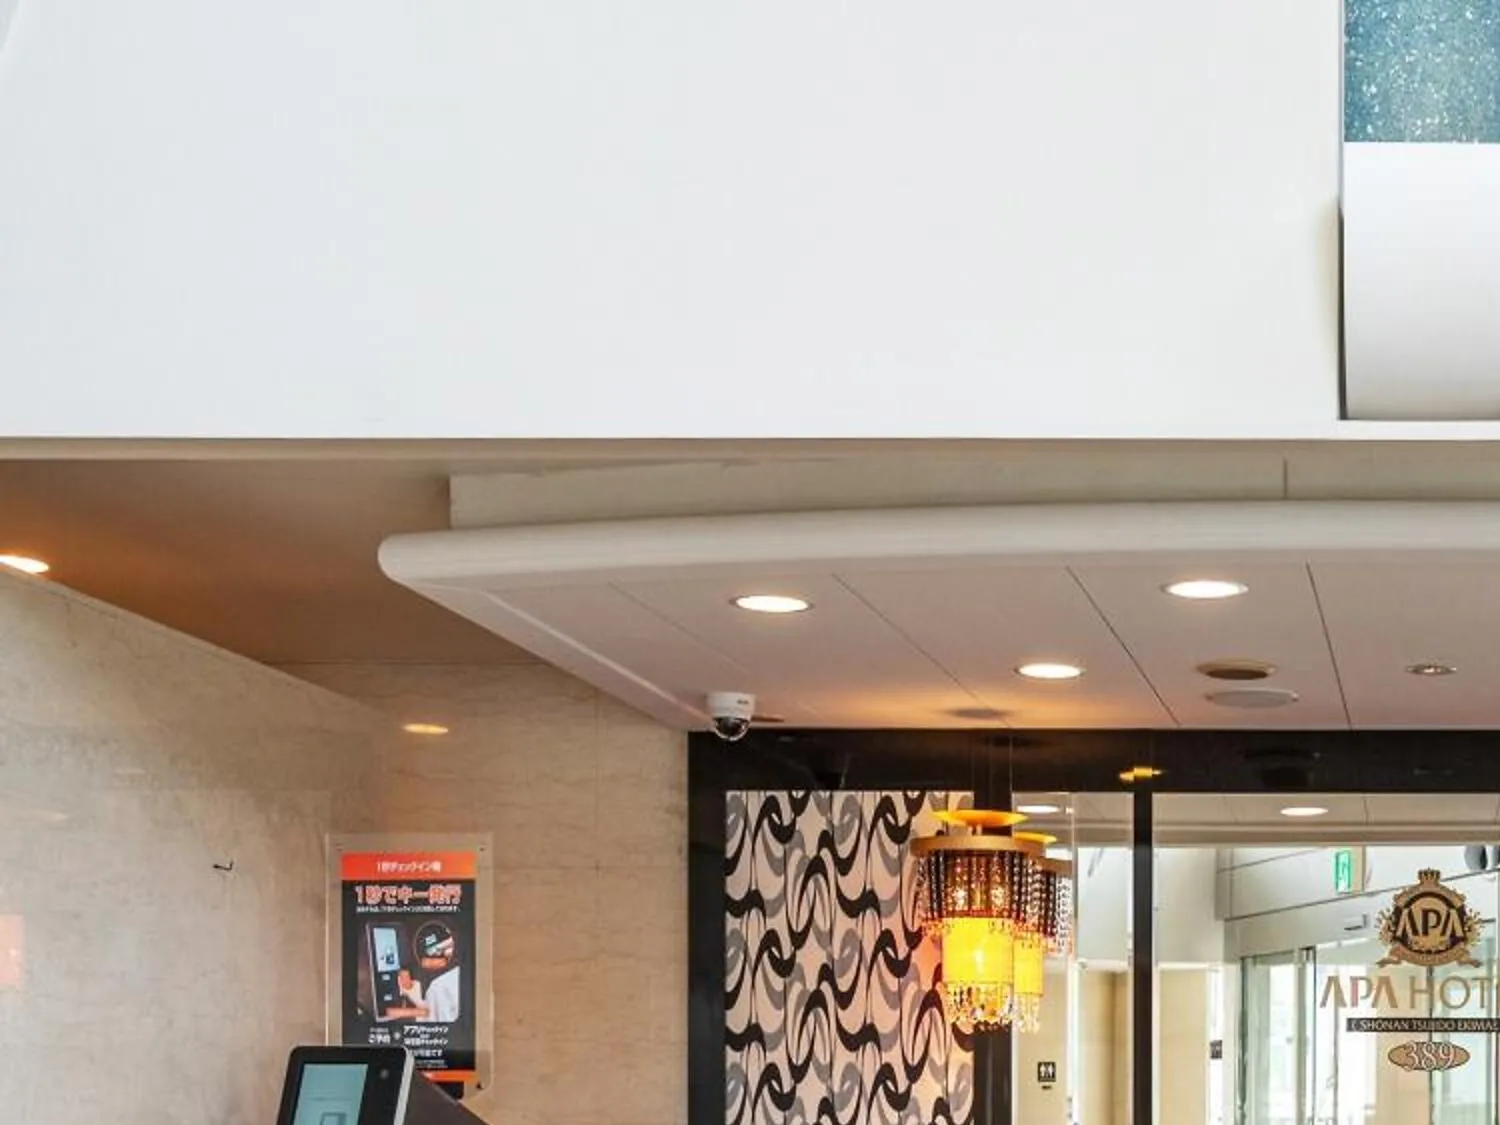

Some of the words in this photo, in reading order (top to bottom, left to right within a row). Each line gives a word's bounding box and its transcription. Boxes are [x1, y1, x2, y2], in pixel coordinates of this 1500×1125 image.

[1395, 907, 1465, 938] APA
[1319, 975, 1398, 1009] APA
[1402, 1040, 1456, 1072] 389
